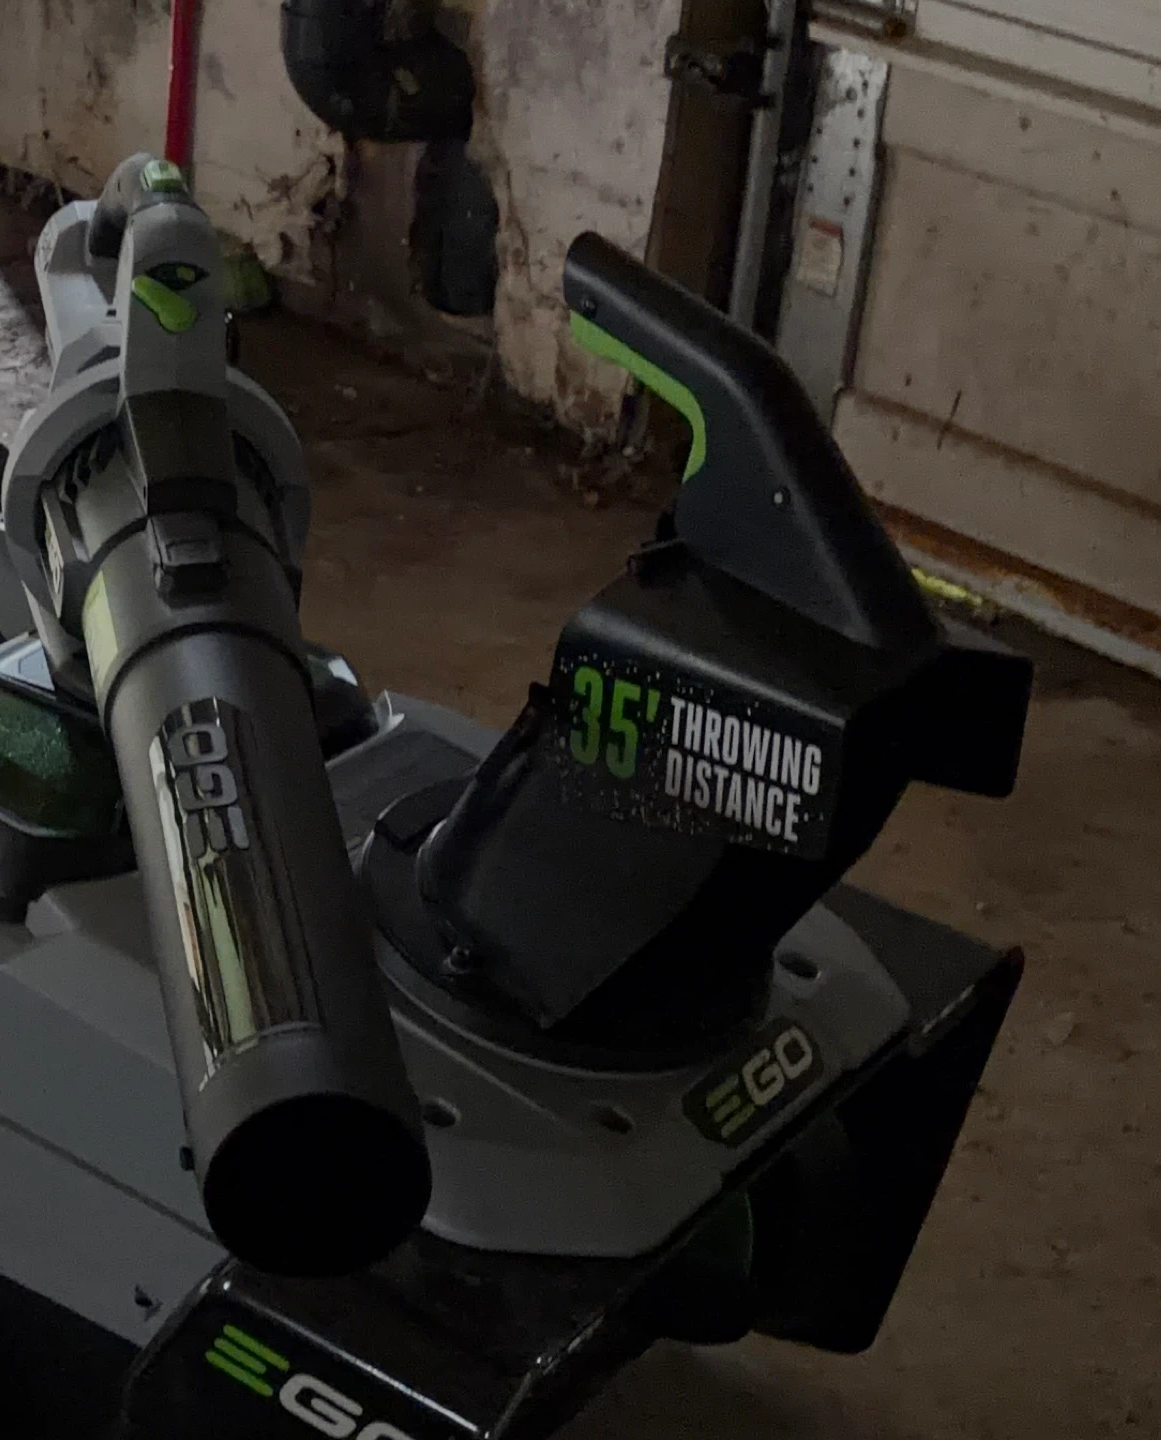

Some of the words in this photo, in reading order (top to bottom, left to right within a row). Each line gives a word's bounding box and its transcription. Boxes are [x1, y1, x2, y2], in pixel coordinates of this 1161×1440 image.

[167, 722, 250, 860] EGO
[664, 747, 801, 843] DISTANCE
[670, 695, 822, 796] THROWING
[705, 1025, 813, 1139] EGO
